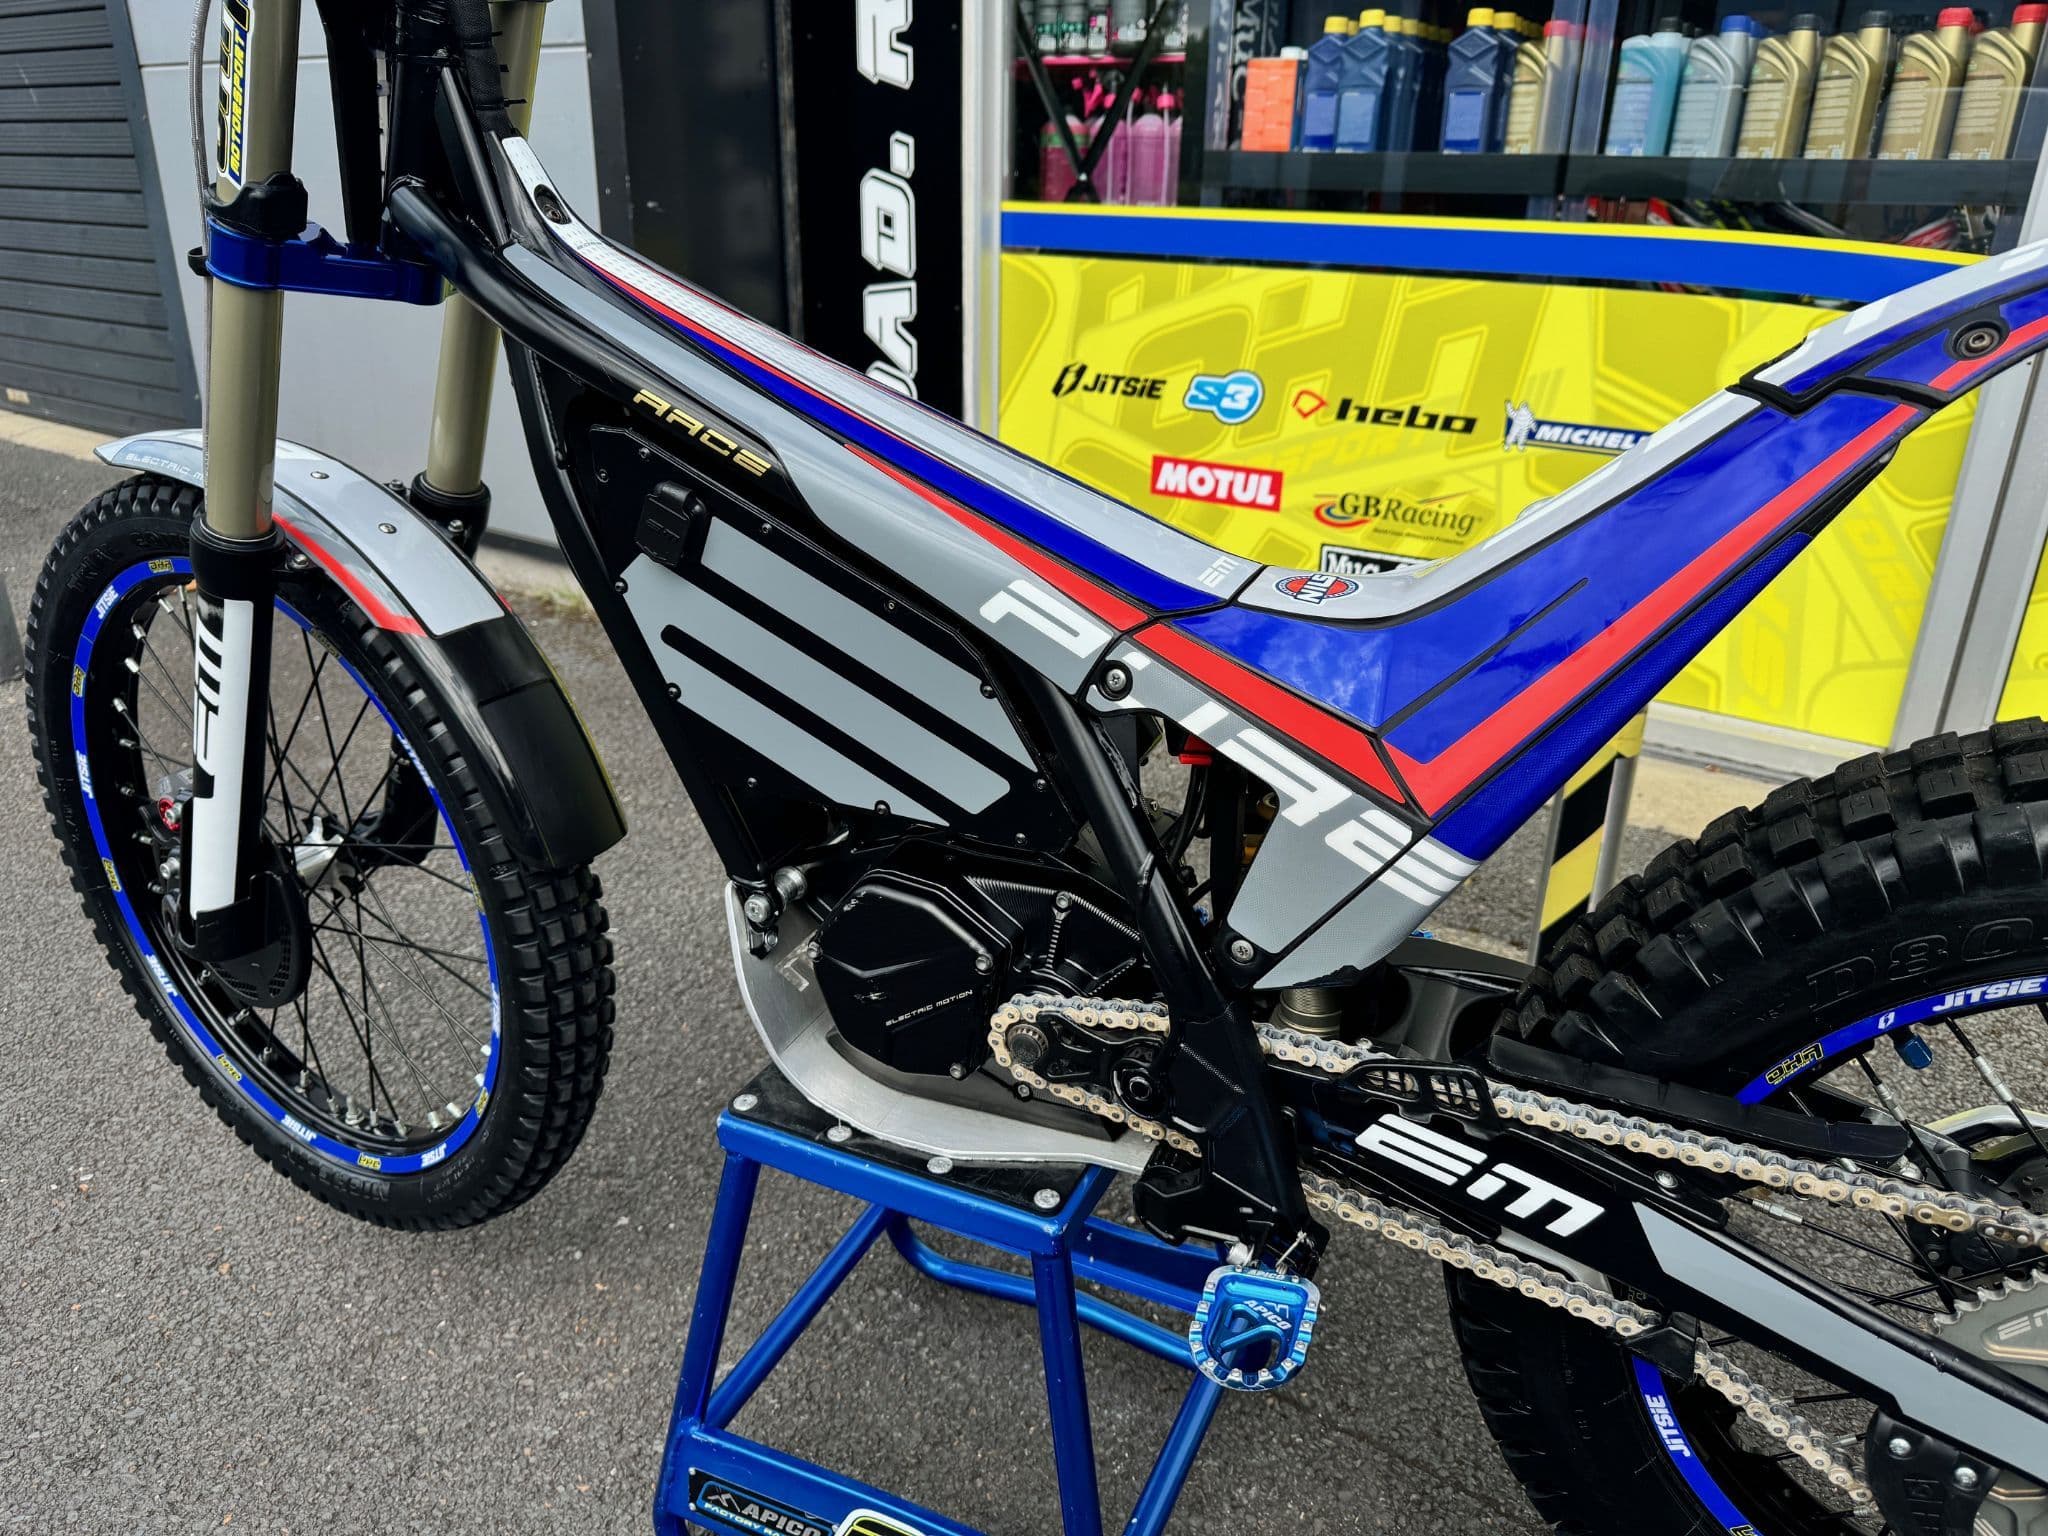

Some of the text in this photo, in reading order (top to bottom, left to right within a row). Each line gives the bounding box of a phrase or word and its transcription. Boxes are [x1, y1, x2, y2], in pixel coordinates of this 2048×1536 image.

[230, 28, 246, 177] MOTORSPORT
[1187, 380, 1257, 413] S3
[632, 388, 772, 477] RACE
[1335, 398, 1478, 434] hebo
[1535, 423, 1642, 451] MICHEL
[125, 453, 191, 475] ELECTRIC
[1155, 462, 1276, 507] MOTUL
[1338, 491, 1476, 536] GBRacing
[885, 988, 974, 1027] ELECTRIC MOTION
[1243, 1300, 1293, 1330] APICO
[704, 1502, 762, 1531] FACTORY
